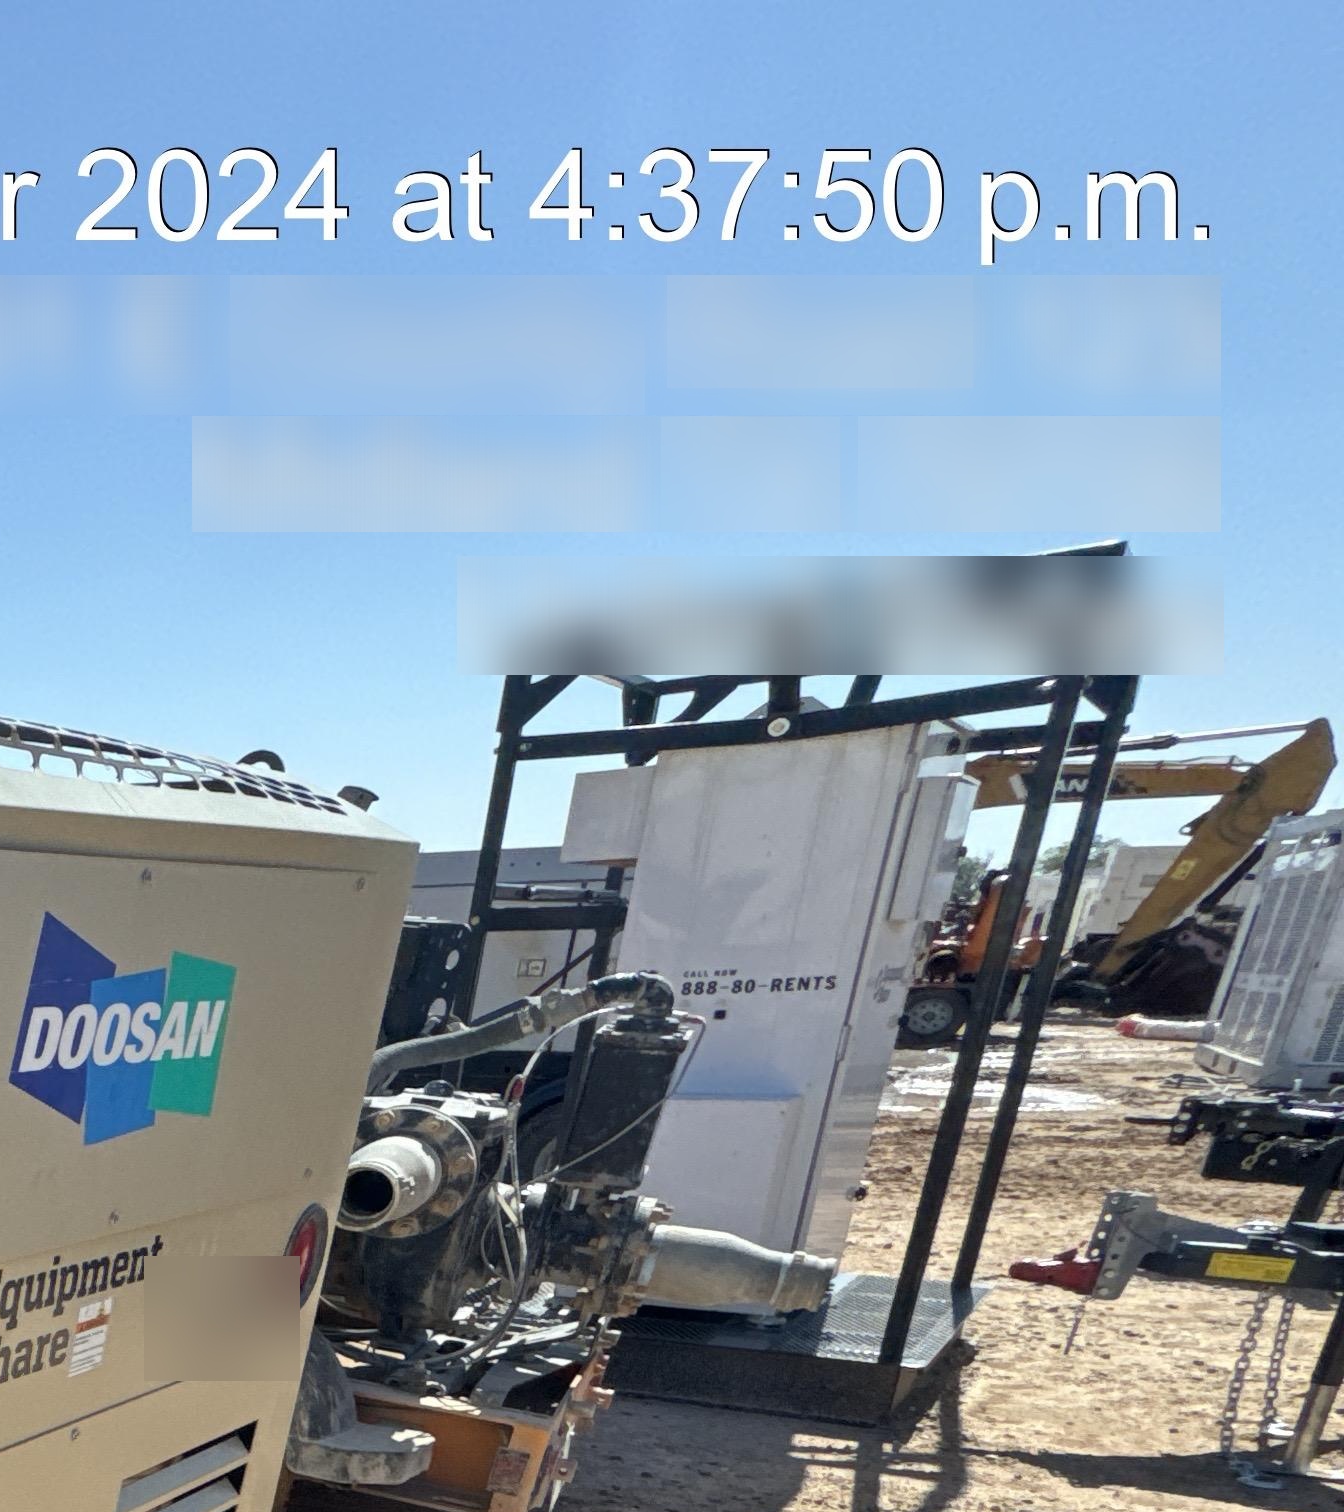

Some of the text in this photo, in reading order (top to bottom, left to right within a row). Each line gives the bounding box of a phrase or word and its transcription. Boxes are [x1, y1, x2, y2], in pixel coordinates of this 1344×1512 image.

[683, 969, 738, 979] CALL NOW
[680, 975, 838, 996] 888-80-RENTS
[18, 1000, 226, 1073] DOOSAN
